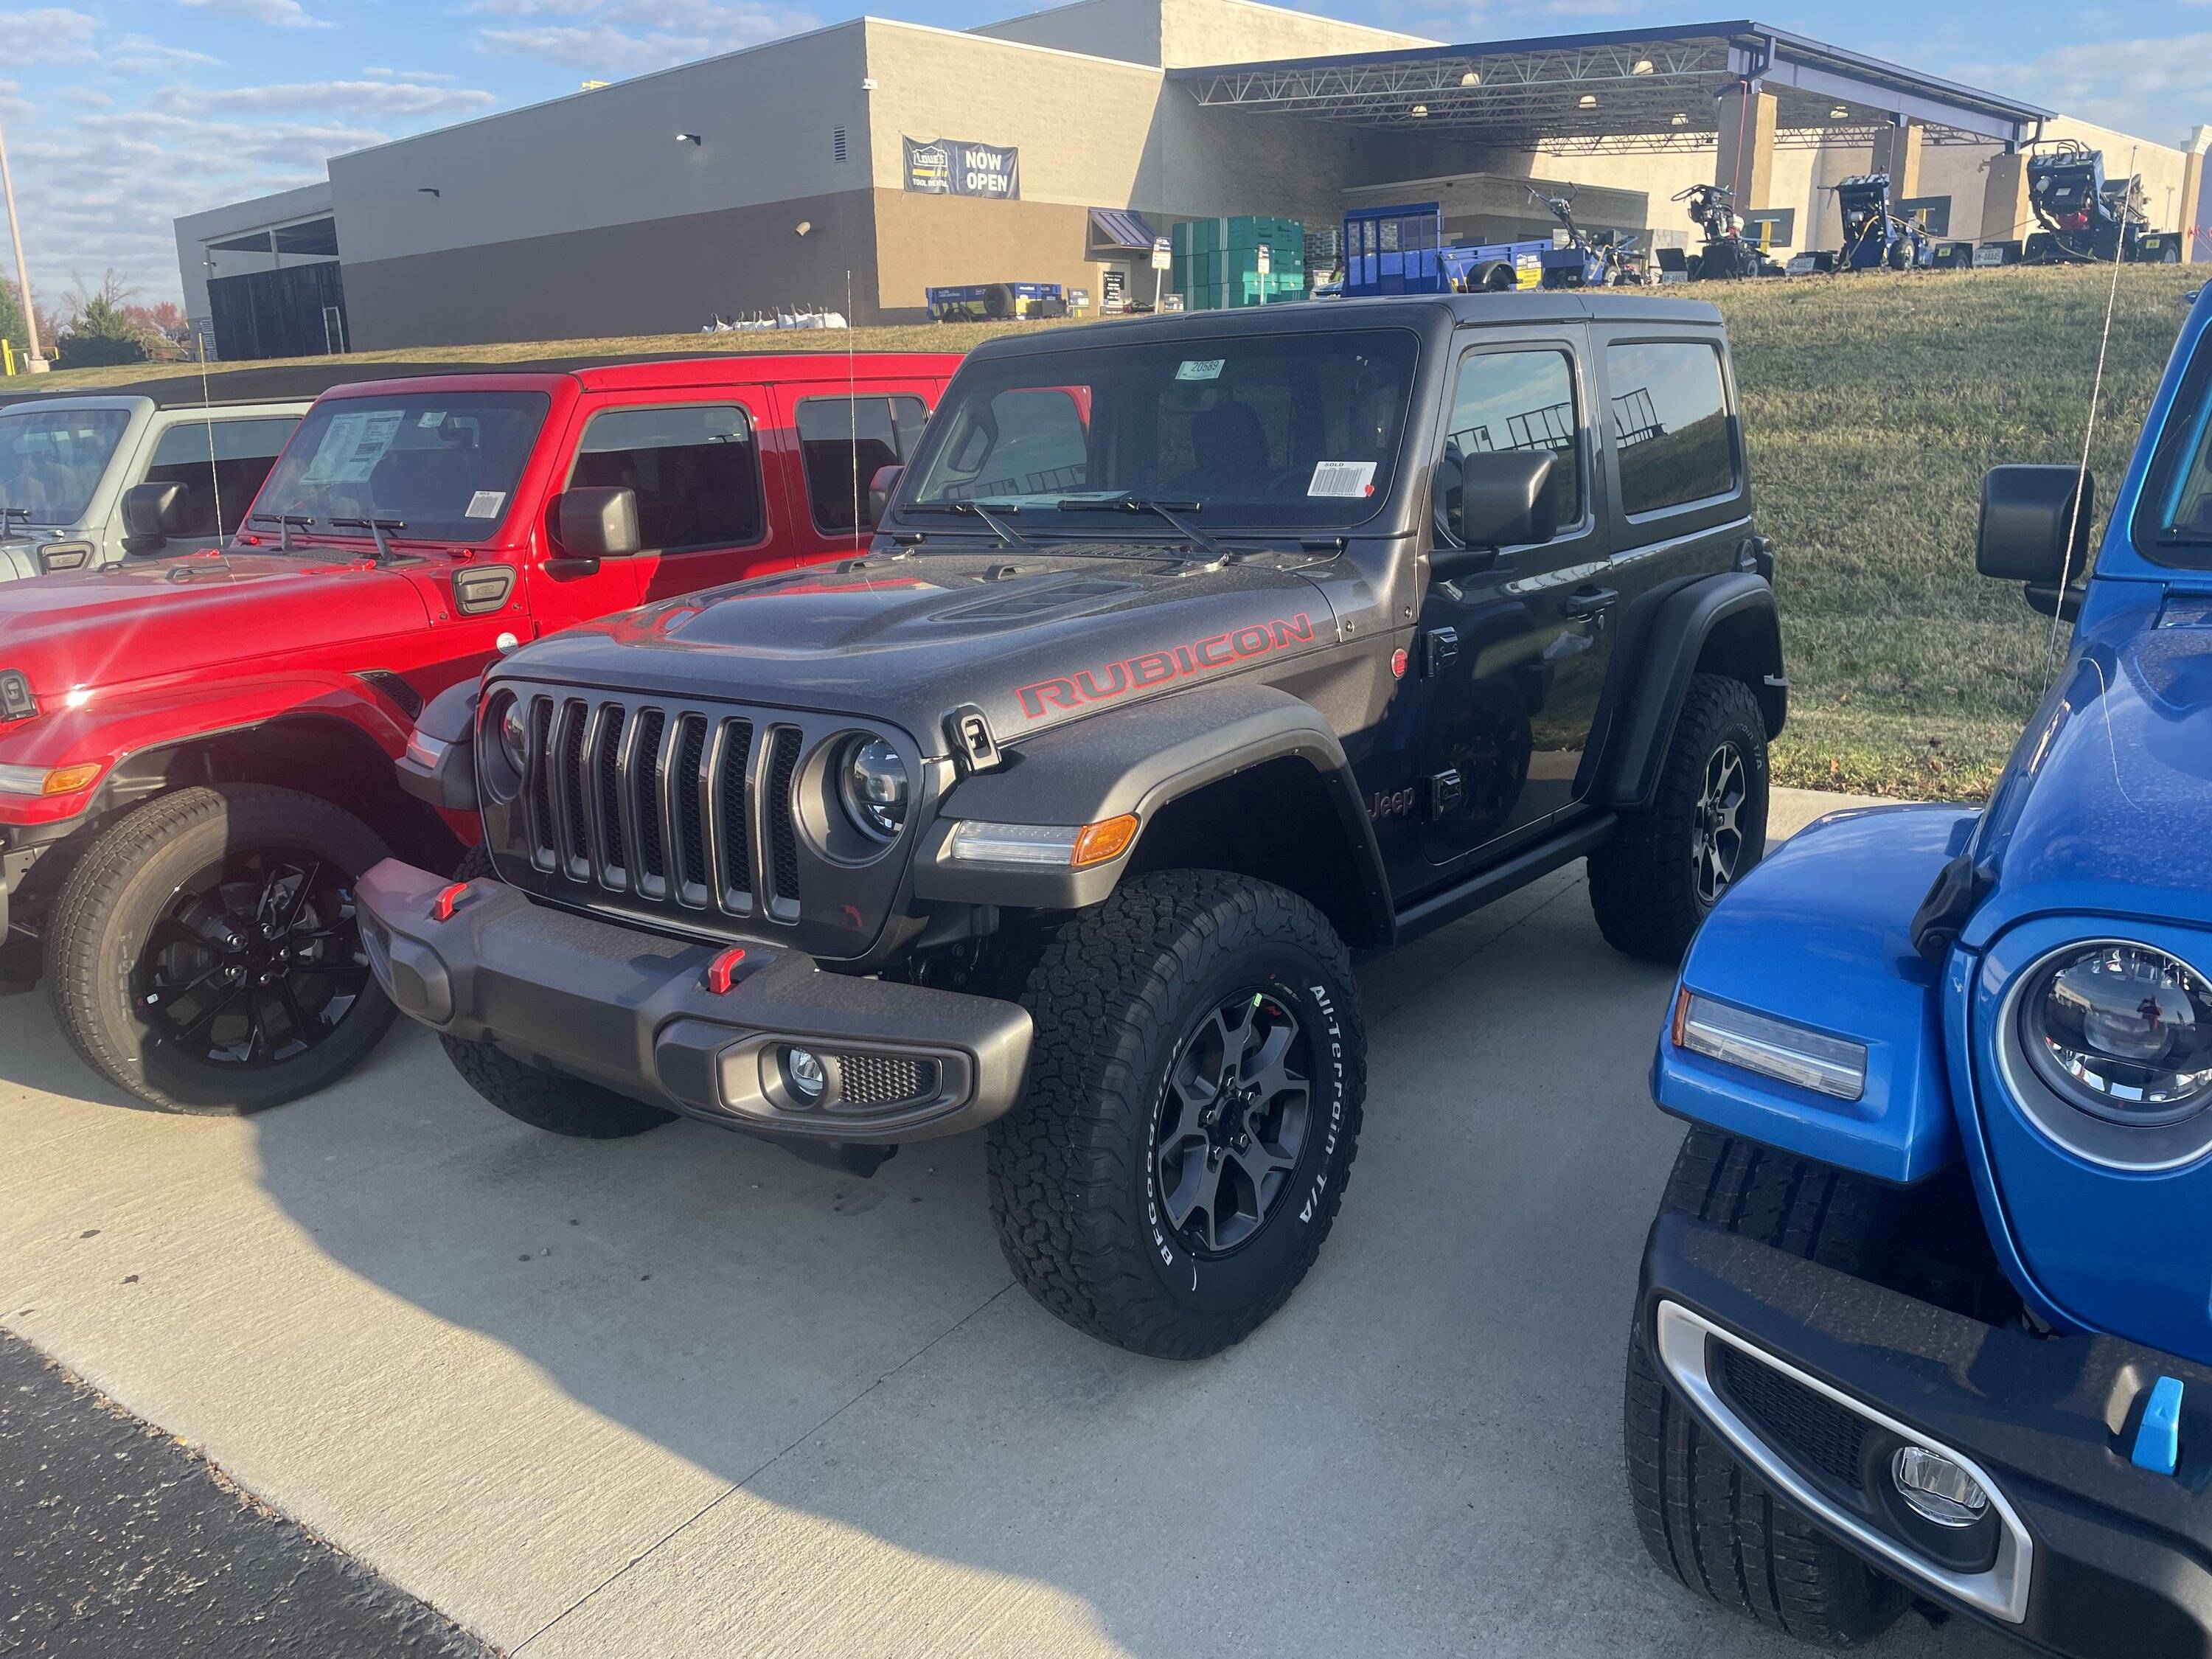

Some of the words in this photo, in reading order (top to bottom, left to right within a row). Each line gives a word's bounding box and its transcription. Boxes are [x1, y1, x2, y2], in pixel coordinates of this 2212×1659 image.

[965, 150, 1001, 170] NOW
[967, 172, 1007, 192] OPEN
[1015, 613, 1315, 719] RUBICON
[1366, 787, 1416, 820] Jeep
[1309, 984, 1343, 1155] All-Terrain
[1299, 1173, 1327, 1224] T/A
